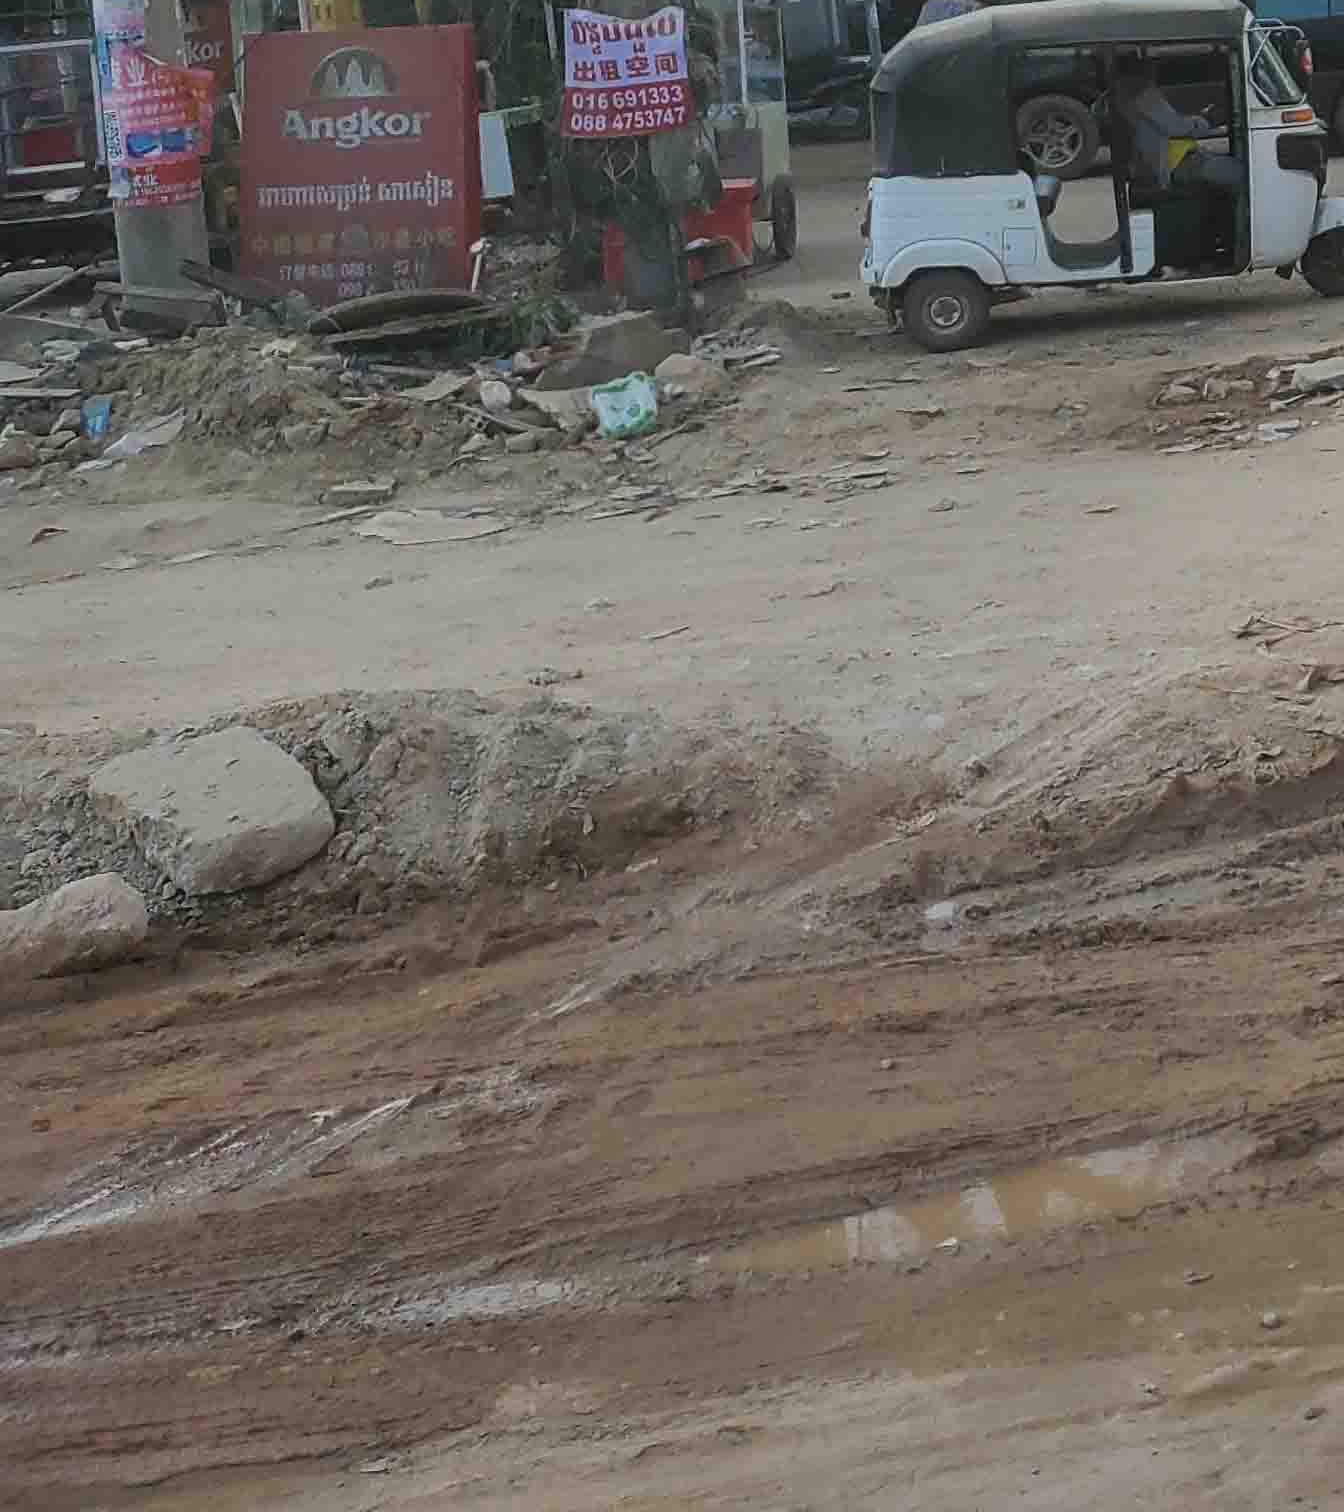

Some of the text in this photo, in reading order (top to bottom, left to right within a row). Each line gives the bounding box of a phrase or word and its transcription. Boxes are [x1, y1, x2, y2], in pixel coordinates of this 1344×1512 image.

[572, 85, 683, 109] 016 691333
[283, 107, 424, 149] Angkor
[612, 107, 685, 130] 4753747
